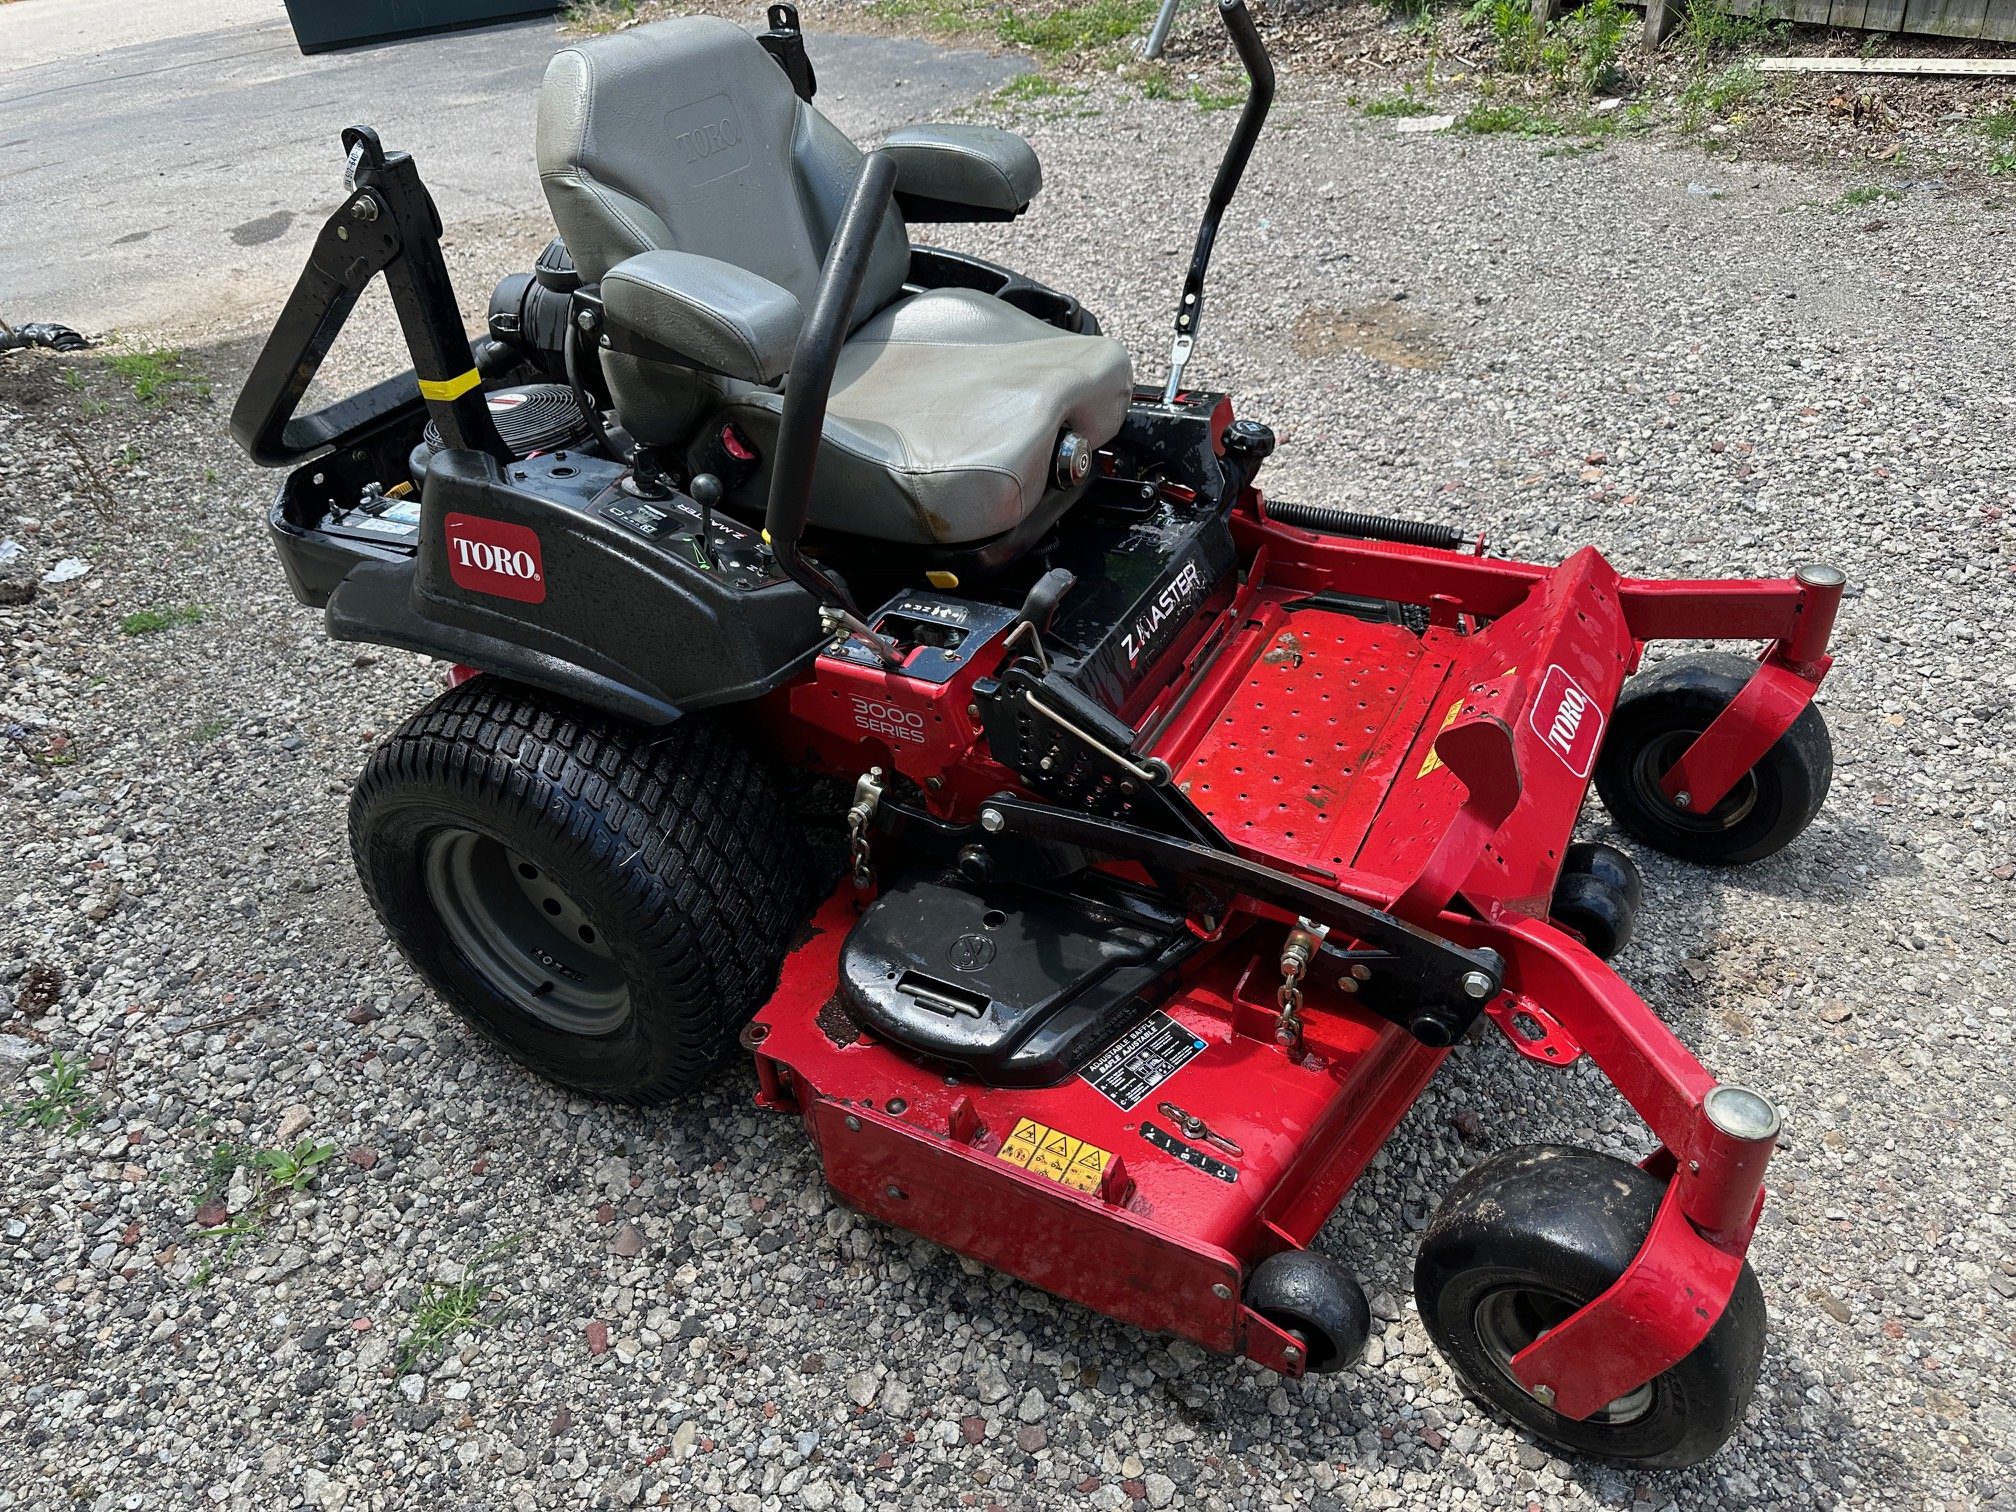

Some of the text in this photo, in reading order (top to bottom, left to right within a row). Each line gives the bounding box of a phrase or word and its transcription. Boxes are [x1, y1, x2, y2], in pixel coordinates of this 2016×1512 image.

[675, 117, 738, 164] TORO
[1120, 562, 1201, 668] Z MASTER
[851, 697, 924, 728] 3000
[854, 715, 926, 744] SERIES
[1548, 687, 1586, 755] TORO
[1089, 1037, 1131, 1072] ADJUSTABLE
[1130, 1019, 1156, 1041] BAFFLE
[1098, 1055, 1123, 1074] BAFLE
[1121, 1026, 1159, 1058] AJUSTABLE
